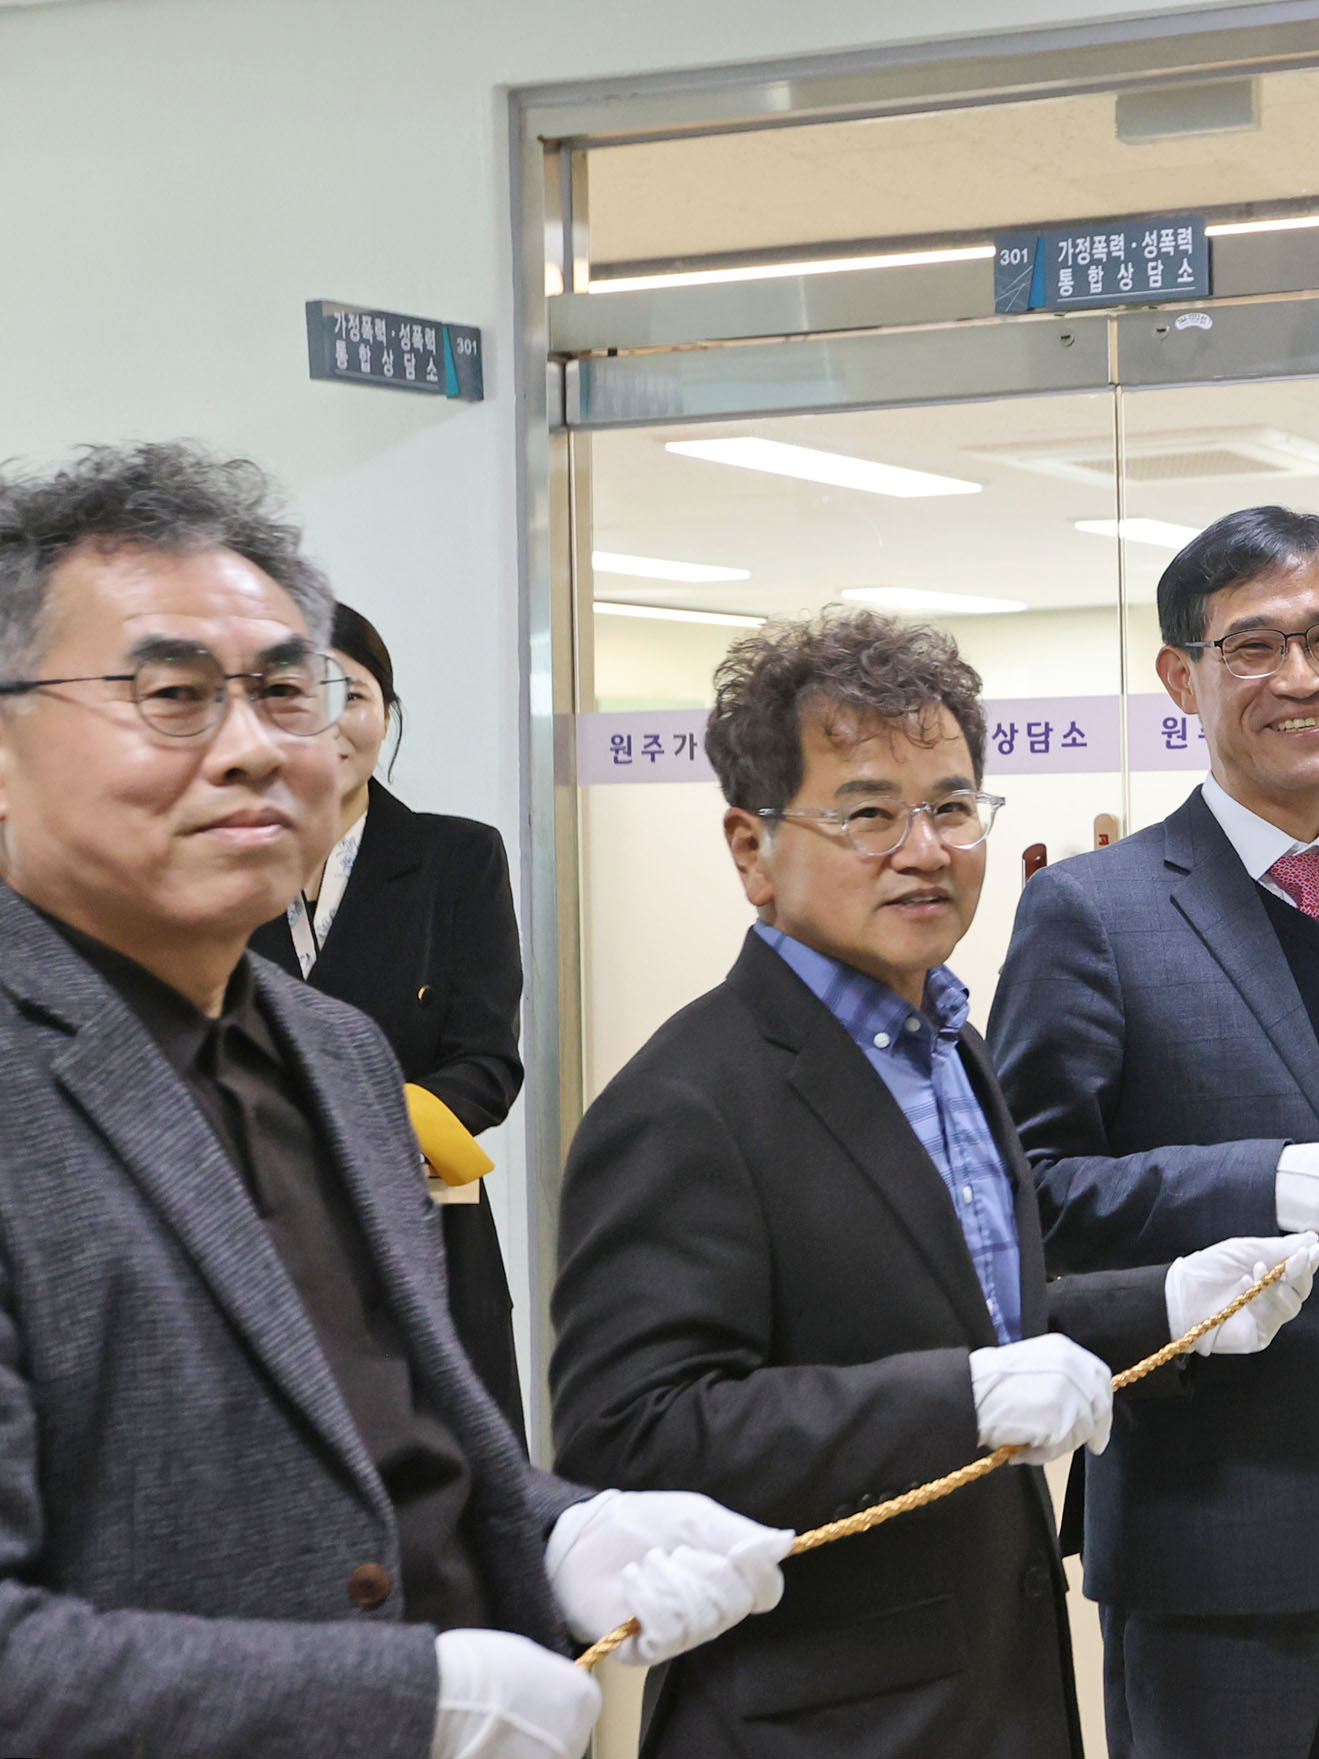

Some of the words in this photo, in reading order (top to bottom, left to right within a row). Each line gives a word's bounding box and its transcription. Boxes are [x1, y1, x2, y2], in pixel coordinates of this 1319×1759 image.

[1000, 248, 1029, 266] 301
[456, 337, 478, 356] 301
[609, 732, 698, 765] 원주가
